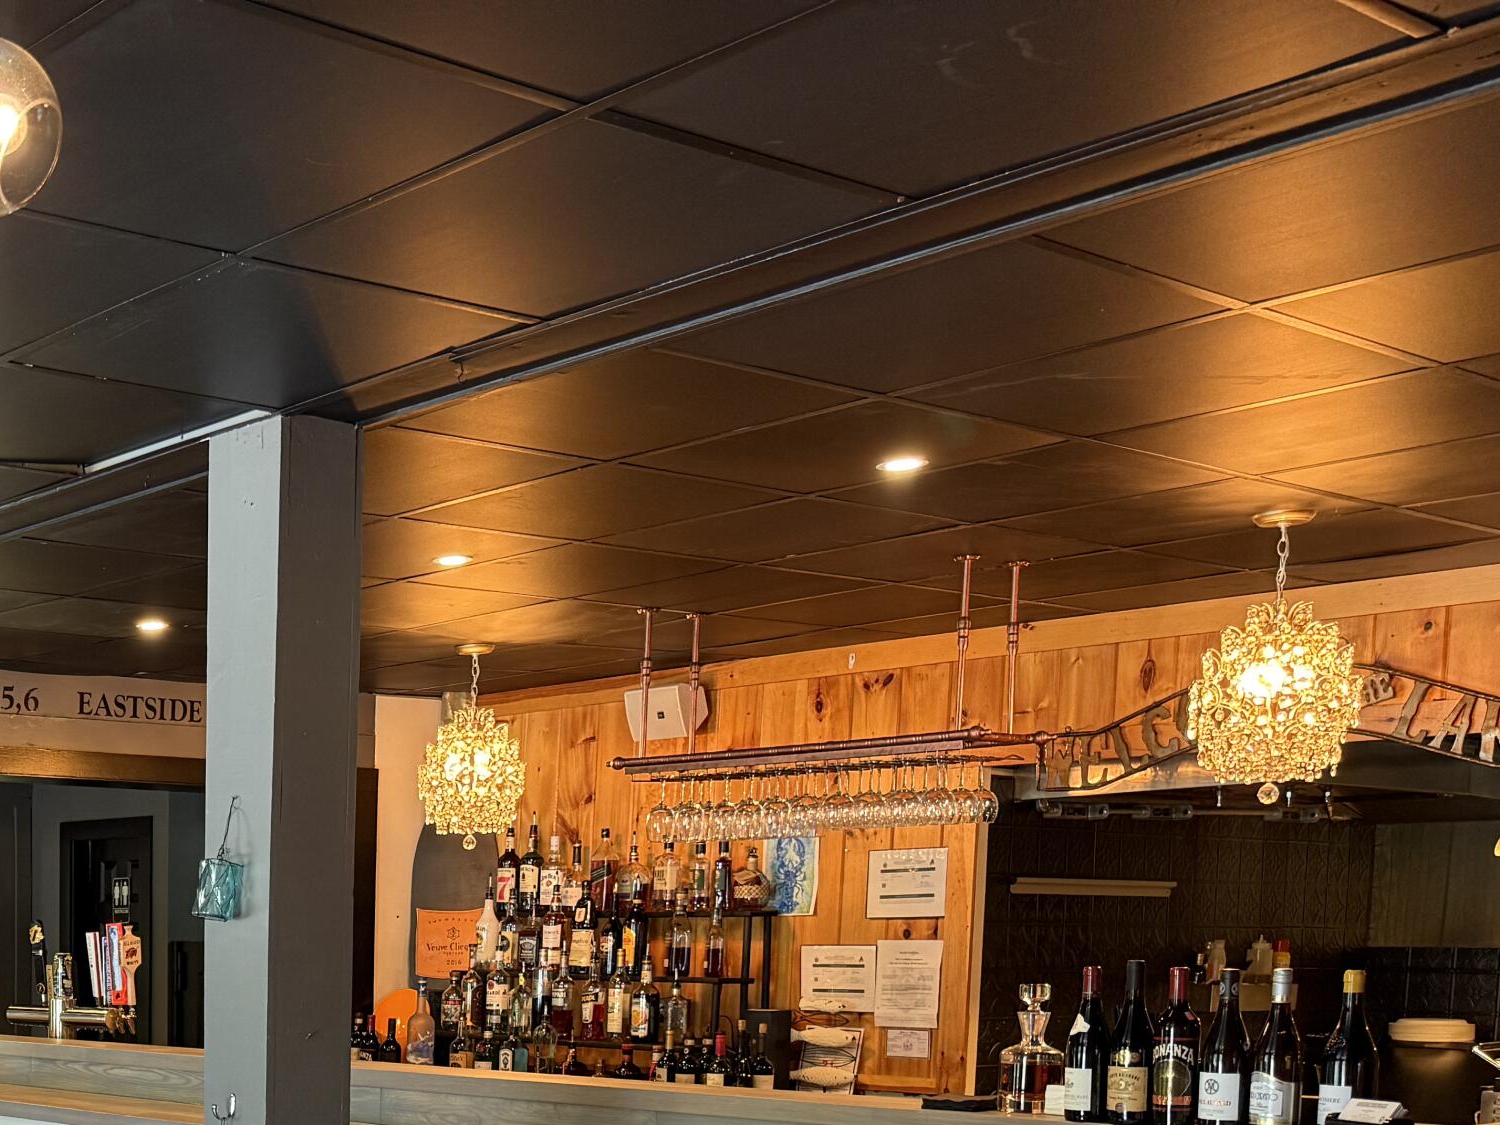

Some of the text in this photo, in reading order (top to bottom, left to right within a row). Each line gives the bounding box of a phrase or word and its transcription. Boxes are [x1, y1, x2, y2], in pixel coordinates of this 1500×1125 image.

[77, 690, 202, 724] EASTSIDE
[498, 876, 511, 901] 7
[426, 942, 469, 952] Veuve Clicq
